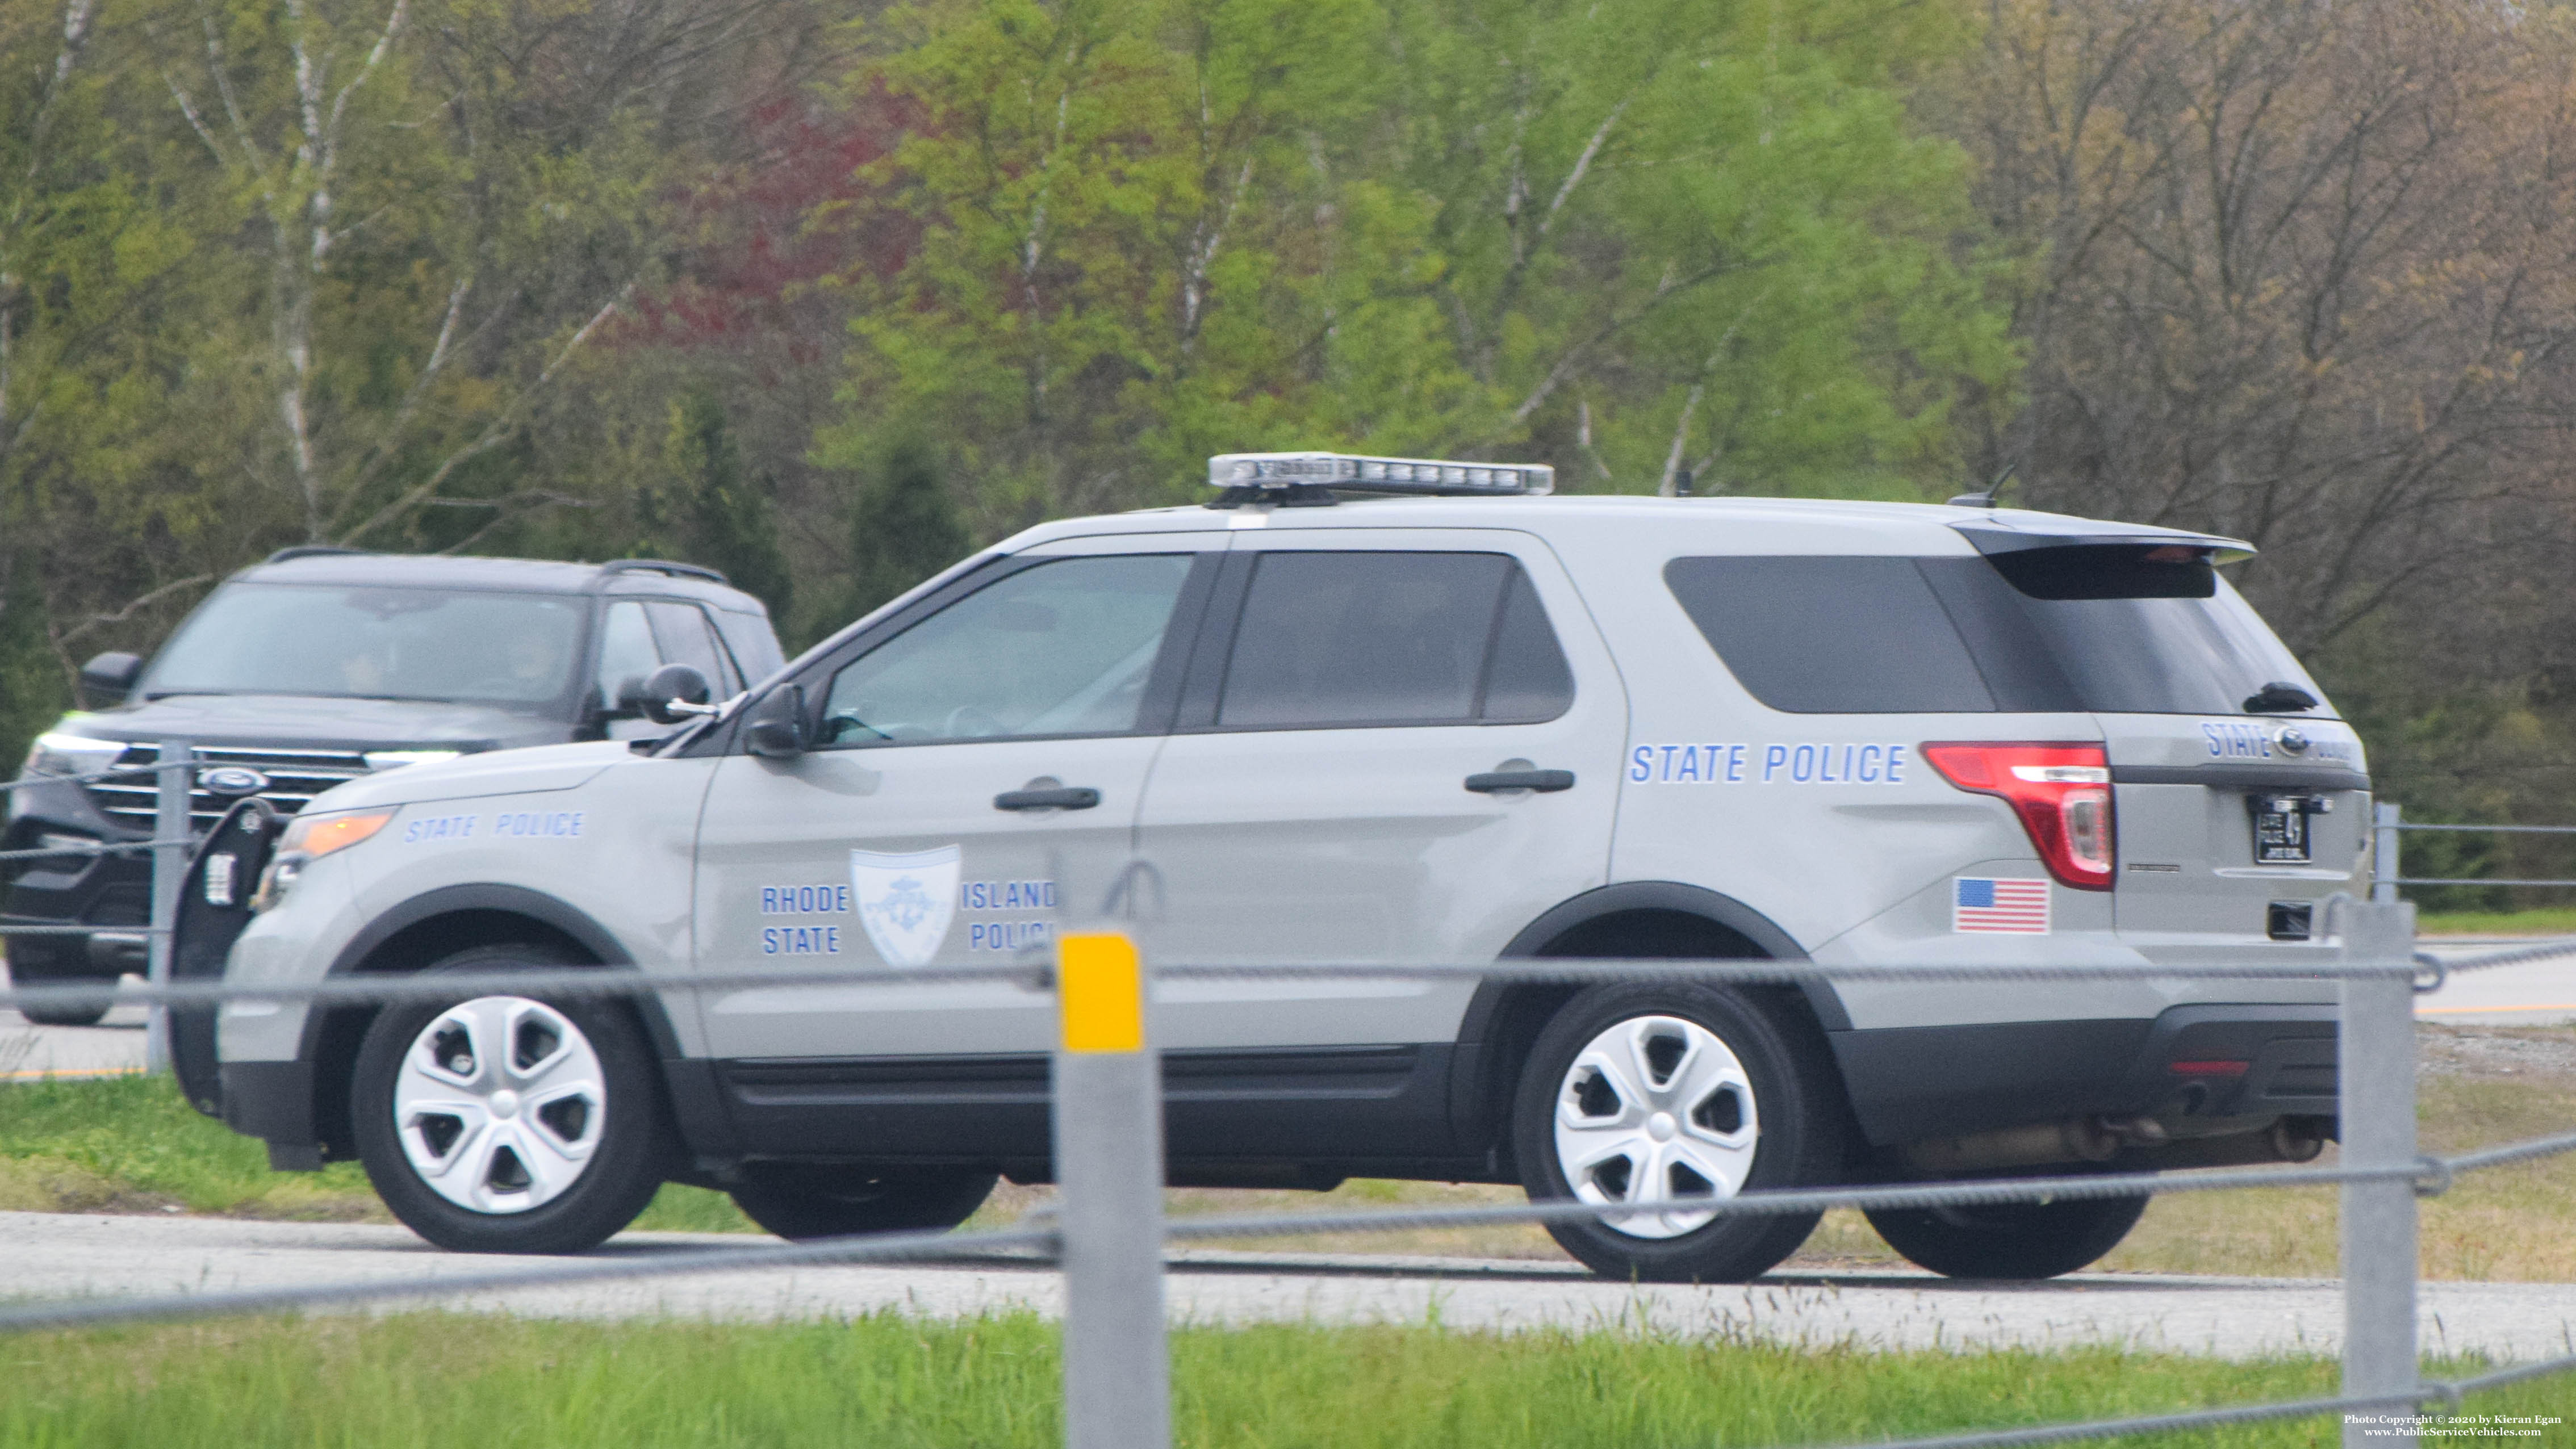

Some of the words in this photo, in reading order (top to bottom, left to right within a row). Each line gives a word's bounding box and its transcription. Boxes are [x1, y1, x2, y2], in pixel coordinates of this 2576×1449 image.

[2201, 723, 2270, 757] STATE
[1631, 744, 1746, 782] STATE
[1763, 744, 1905, 782] POLICE
[405, 815, 479, 843] STATE
[495, 813, 584, 836] POLICE
[762, 885, 848, 912] RHODE
[763, 927, 839, 954] STATE
